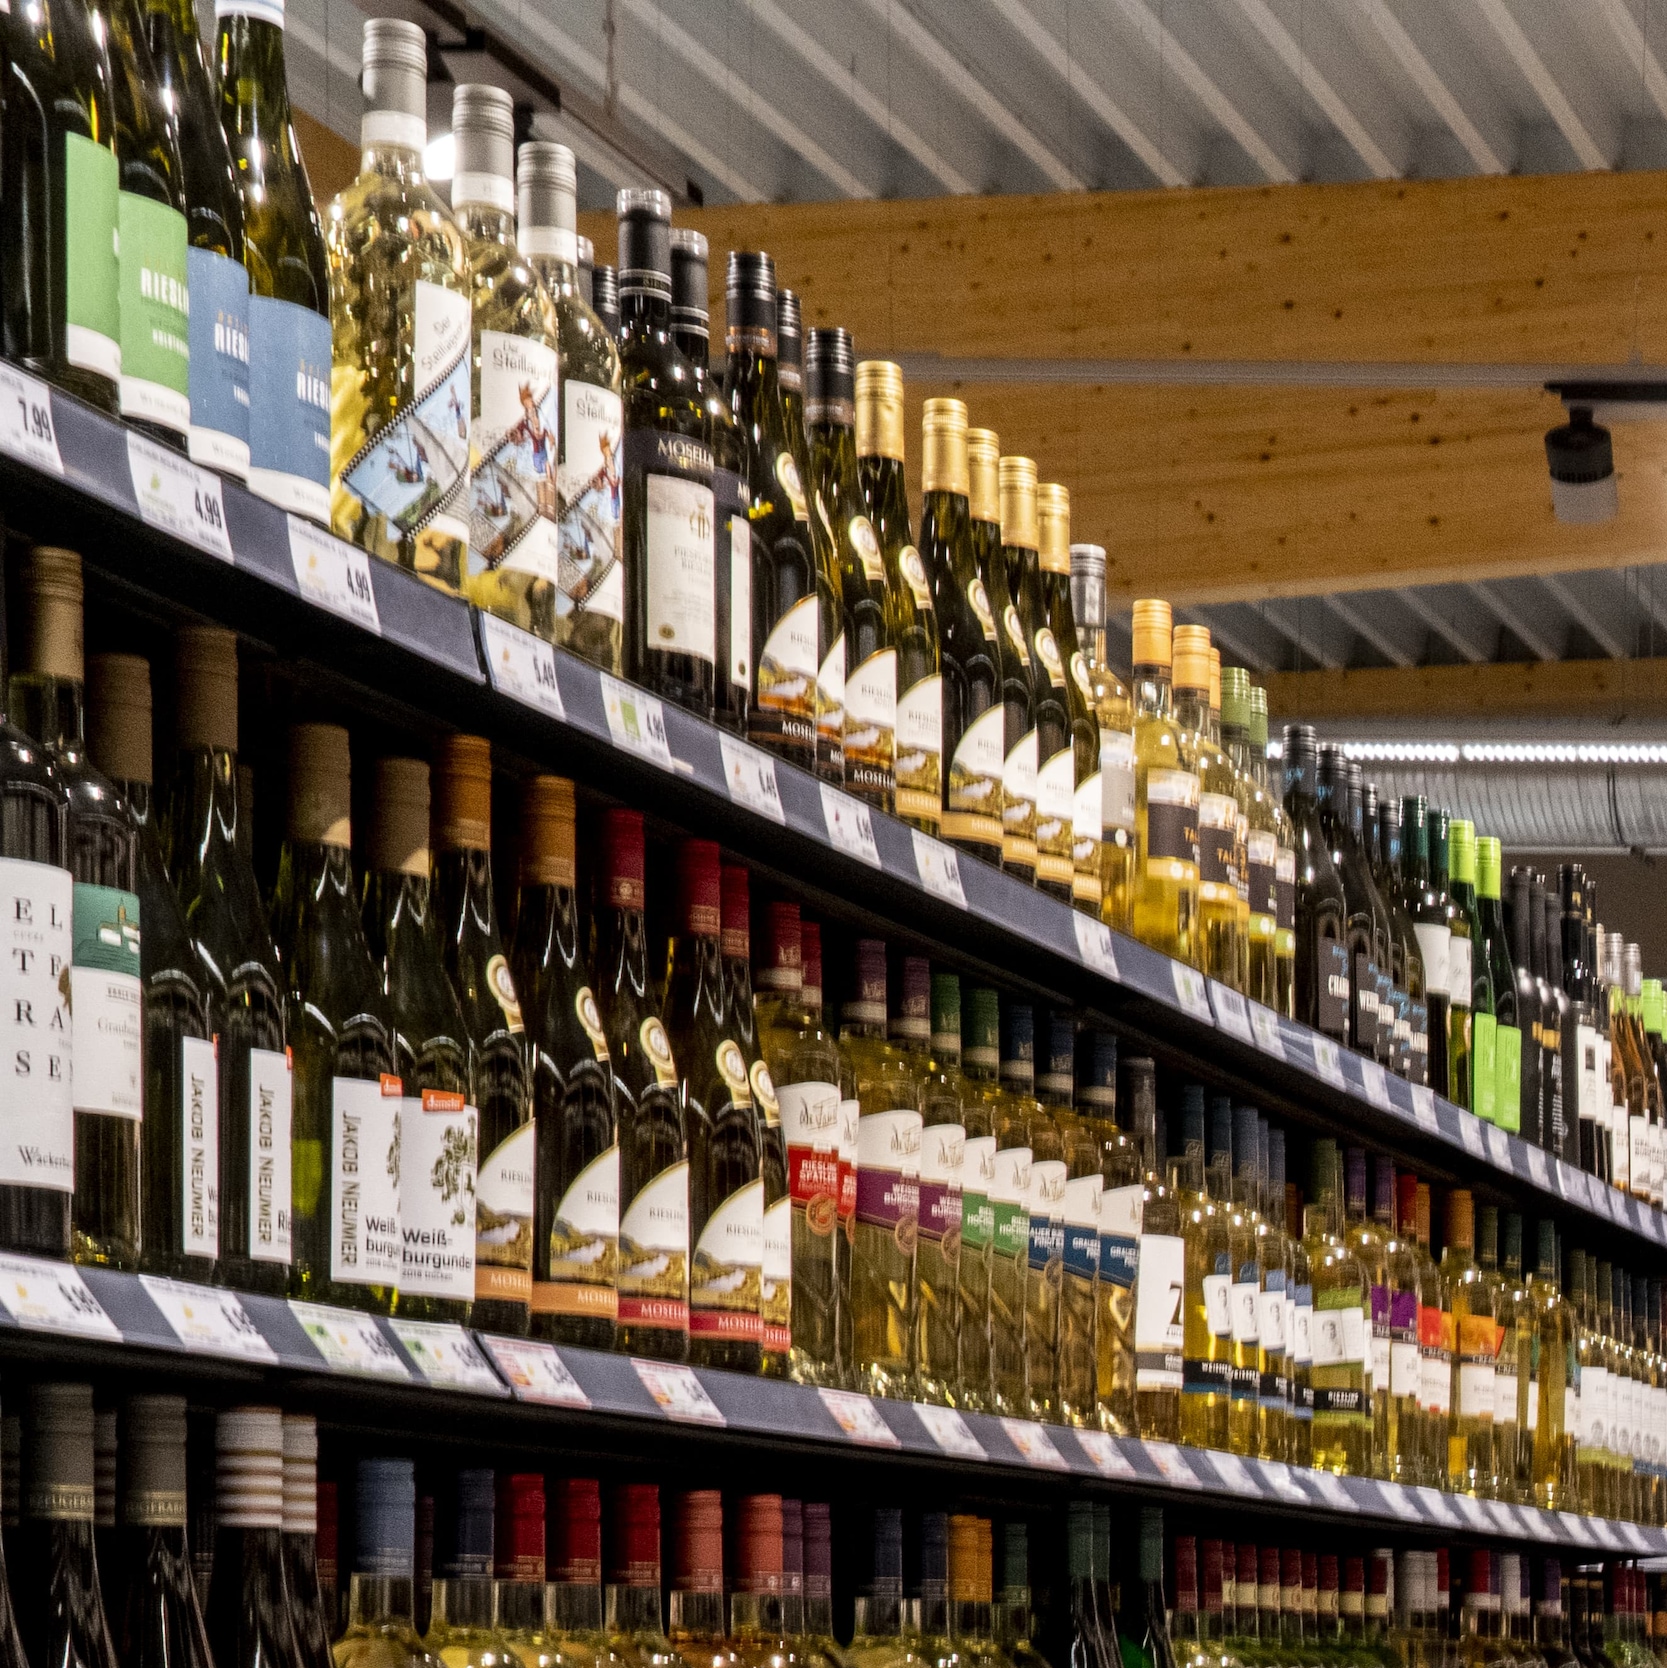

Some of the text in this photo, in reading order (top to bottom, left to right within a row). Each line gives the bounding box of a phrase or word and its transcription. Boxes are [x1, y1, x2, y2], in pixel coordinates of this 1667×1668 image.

[18, 397, 52, 443] 7.99
[194, 494, 221, 529] 4.99
[345, 569, 372, 602] 4.99
[190, 1072, 205, 1241] JAKOB NEUMER
[258, 1084, 273, 1247] JAKOB NEUMER
[340, 1110, 359, 1269] JAKOB NEUMER
[402, 1228, 453, 1247] Weiß-
